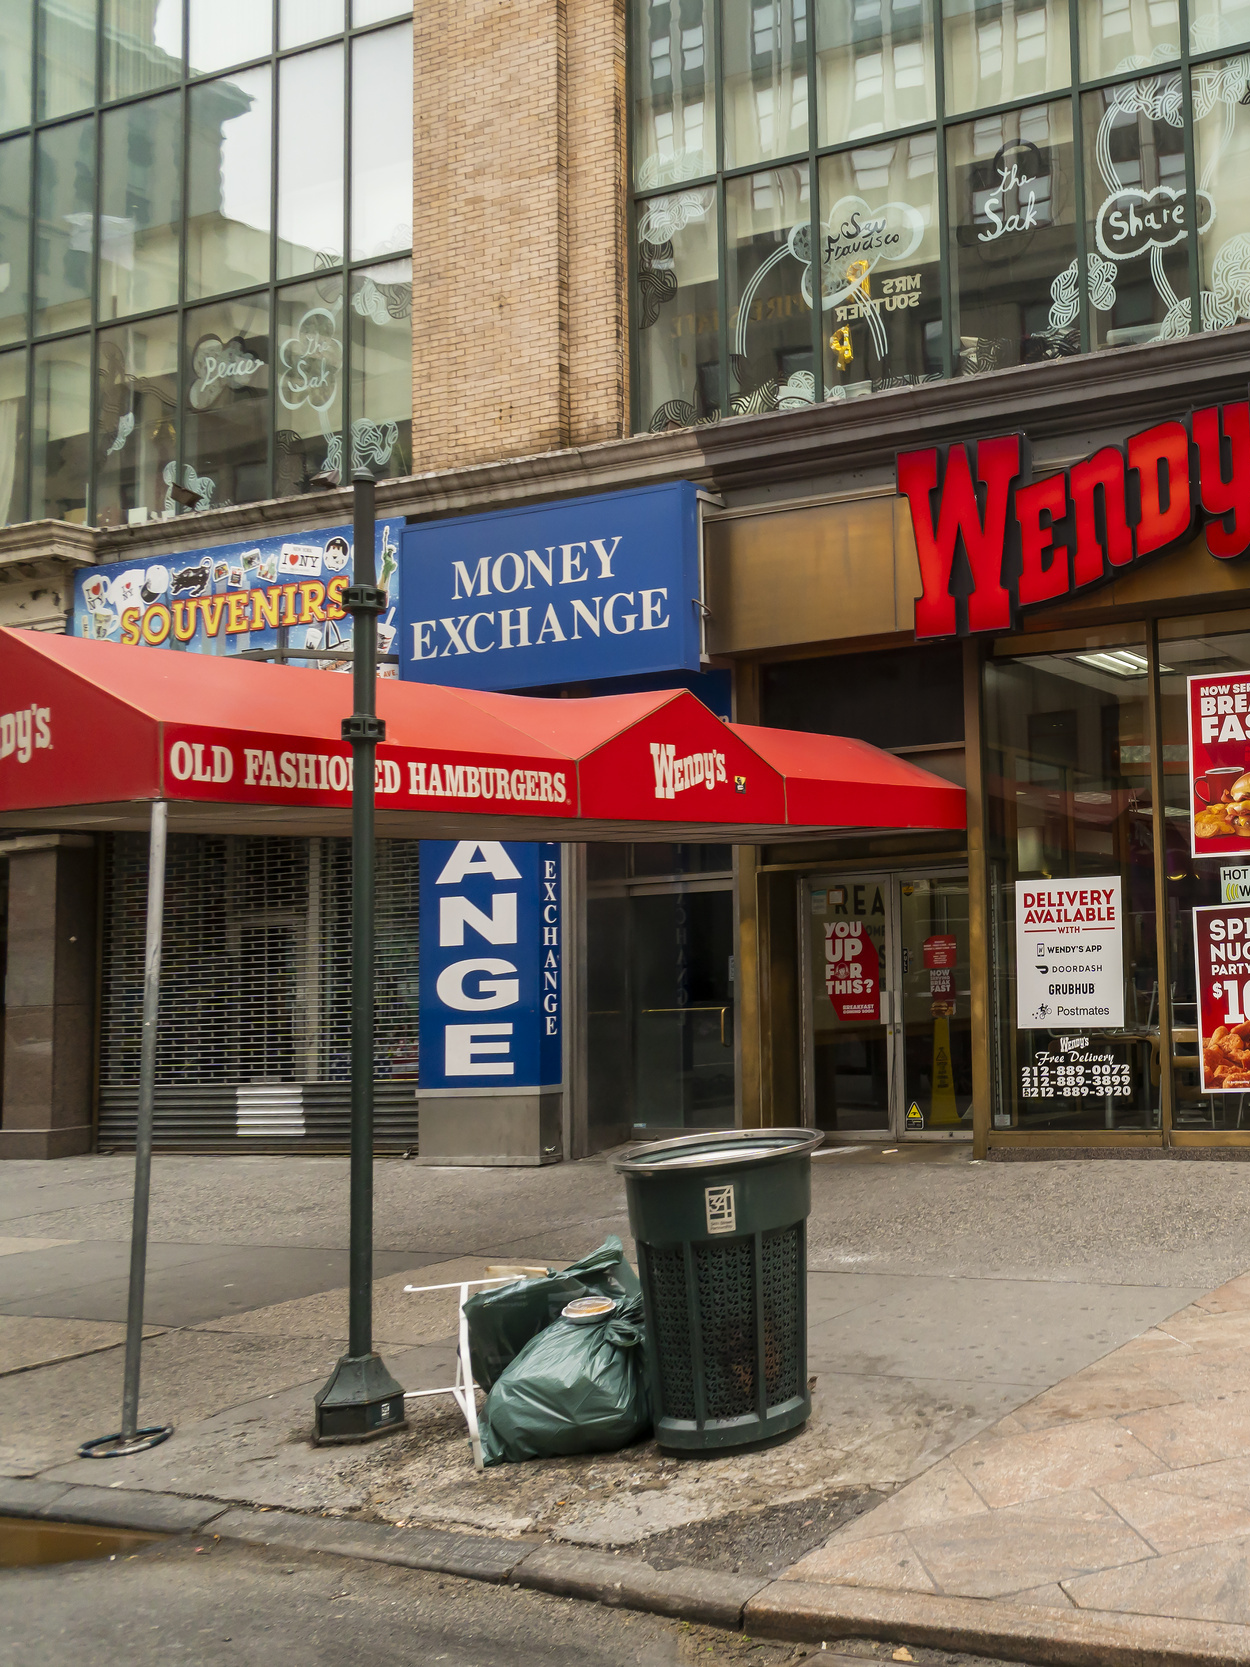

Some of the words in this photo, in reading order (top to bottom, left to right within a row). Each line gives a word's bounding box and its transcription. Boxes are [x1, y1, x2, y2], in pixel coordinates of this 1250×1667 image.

[978, 192, 1037, 241] Sak
[1108, 203, 1184, 241] Share
[200, 356, 264, 392] Peace
[299, 555, 320, 568] NY
[451, 536, 622, 600] MONEY
[121, 575, 349, 646] SOUVENIRS
[410, 588, 670, 661] EXCHANGE
[1200, 685, 1231, 696] NOW
[170, 741, 234, 783] OLD
[408, 762, 567, 803] HAMBURGERS
[1223, 868, 1249, 881] HOT
[1023, 889, 1115, 908] DELIVERY
[1024, 906, 1116, 924] AVAILABLE
[823, 921, 862, 938] YOU
[1057, 926, 1080, 934] WITH
[543, 860, 558, 1035] EXCHANGE
[825, 938, 863, 963] UP
[1047, 945, 1084, 954] WENDY'S
[1085, 944, 1102, 952] APP
[930, 969, 950, 977] NOW
[1052, 965, 1103, 973] DOORDASH
[825, 979, 874, 995] THIS?
[930, 985, 951, 993] FAST
[1048, 983, 1095, 995] GRUBHUB
[1057, 1005, 1110, 1016] Postmates
[1035, 1051, 1065, 1066] Free
[1068, 1050, 1114, 1065] Delivery
[1021, 1064, 1130, 1077] 212-889-0072
[1021, 1075, 1131, 1087] 212-889-3899
[1030, 1086, 1131, 1097] 212-889-3920
